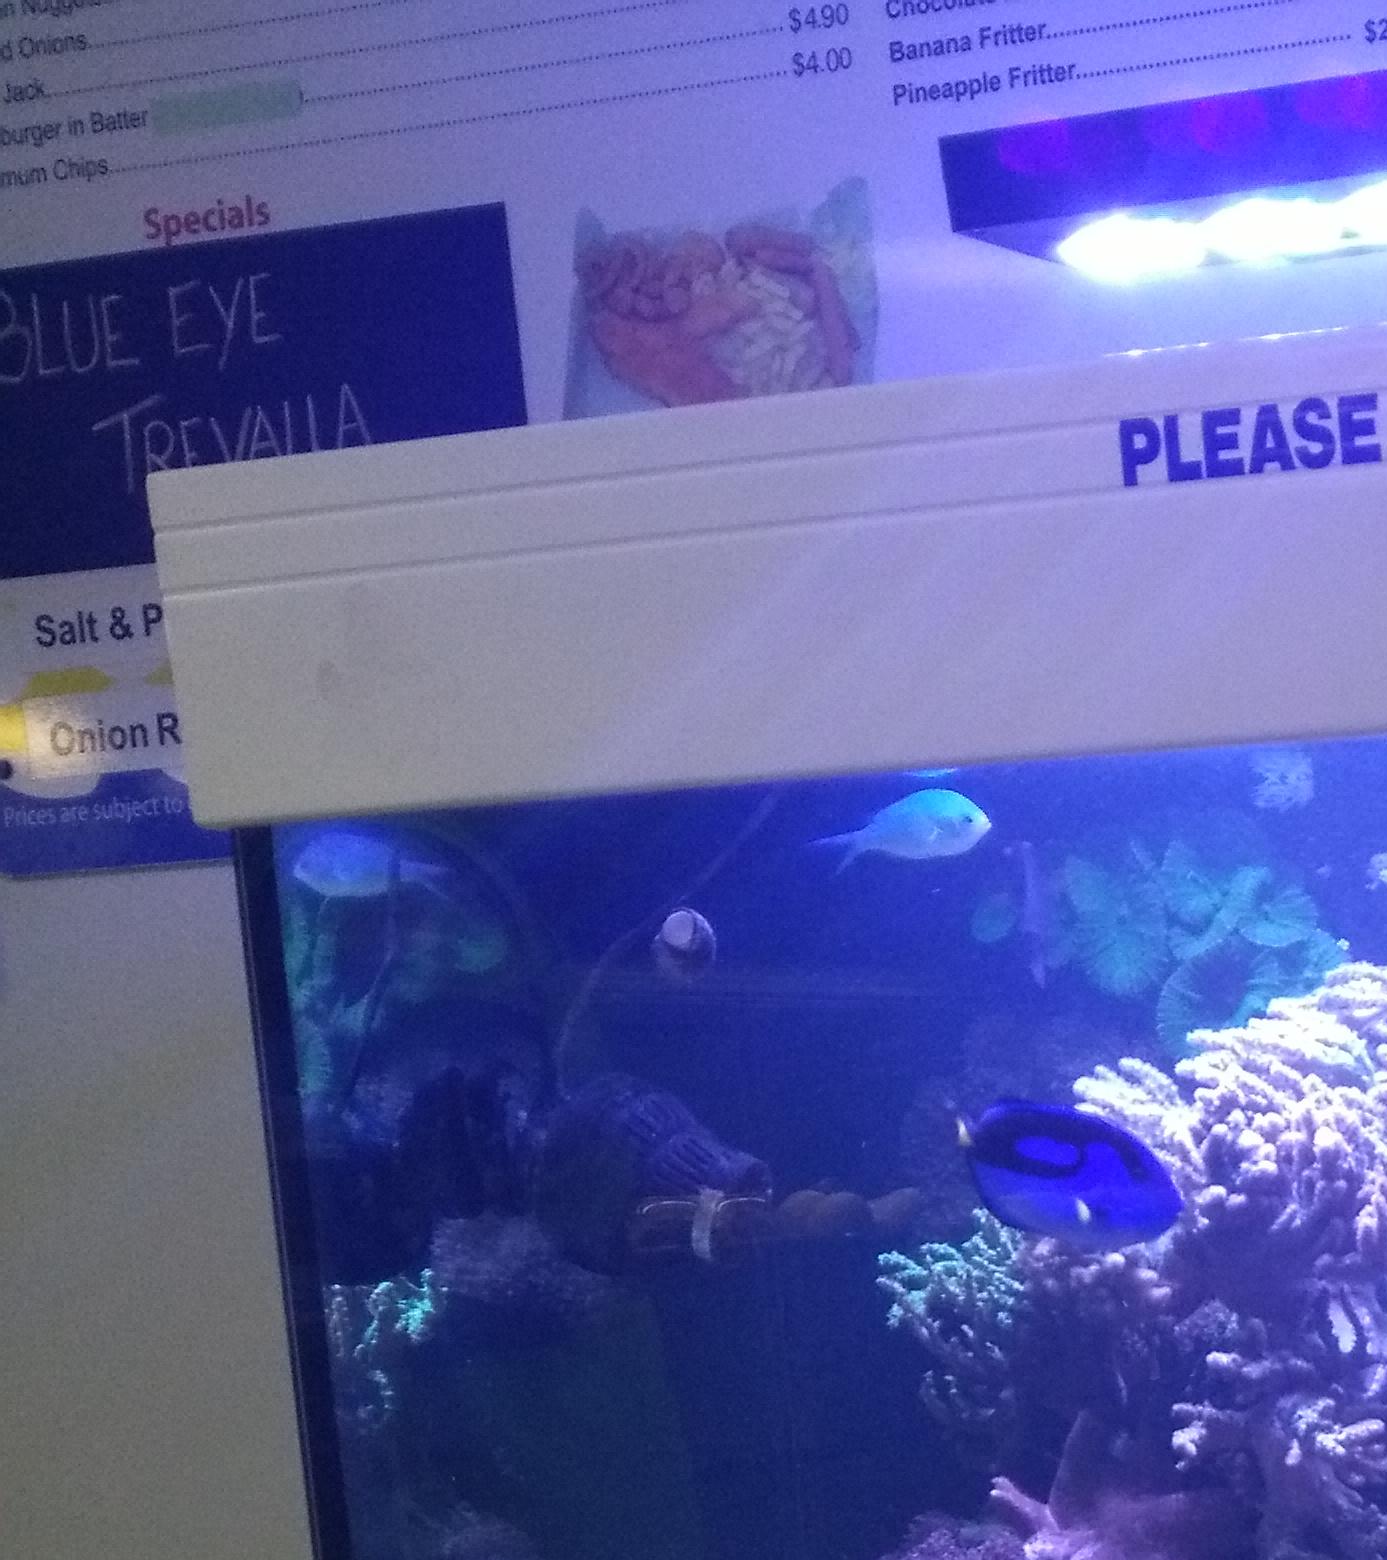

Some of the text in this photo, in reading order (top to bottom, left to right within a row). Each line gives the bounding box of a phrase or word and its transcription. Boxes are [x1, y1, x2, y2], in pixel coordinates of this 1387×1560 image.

[21, 0, 101, 17] Nugge
[788, 2, 850, 33] $4.90
[886, 0, 996, 18] Choco
[18, 34, 87, 59] Onions
[889, 20, 1048, 63] Banana Fritter
[792, 47, 853, 77] $4.00
[893, 61, 1079, 106] Pineapple Fritter
[67, 115, 85, 137] in
[90, 109, 149, 134] Batter
[53, 157, 109, 183] Chips
[143, 194, 271, 246] Specials
[168, 272, 283, 370] EYE
[1118, 392, 1382, 487] PLEASE
[34, 610, 99, 648] Salt
[109, 606, 134, 641] &
[50, 719, 149, 756] Onion
[3, 796, 184, 828] Prices are subject to
